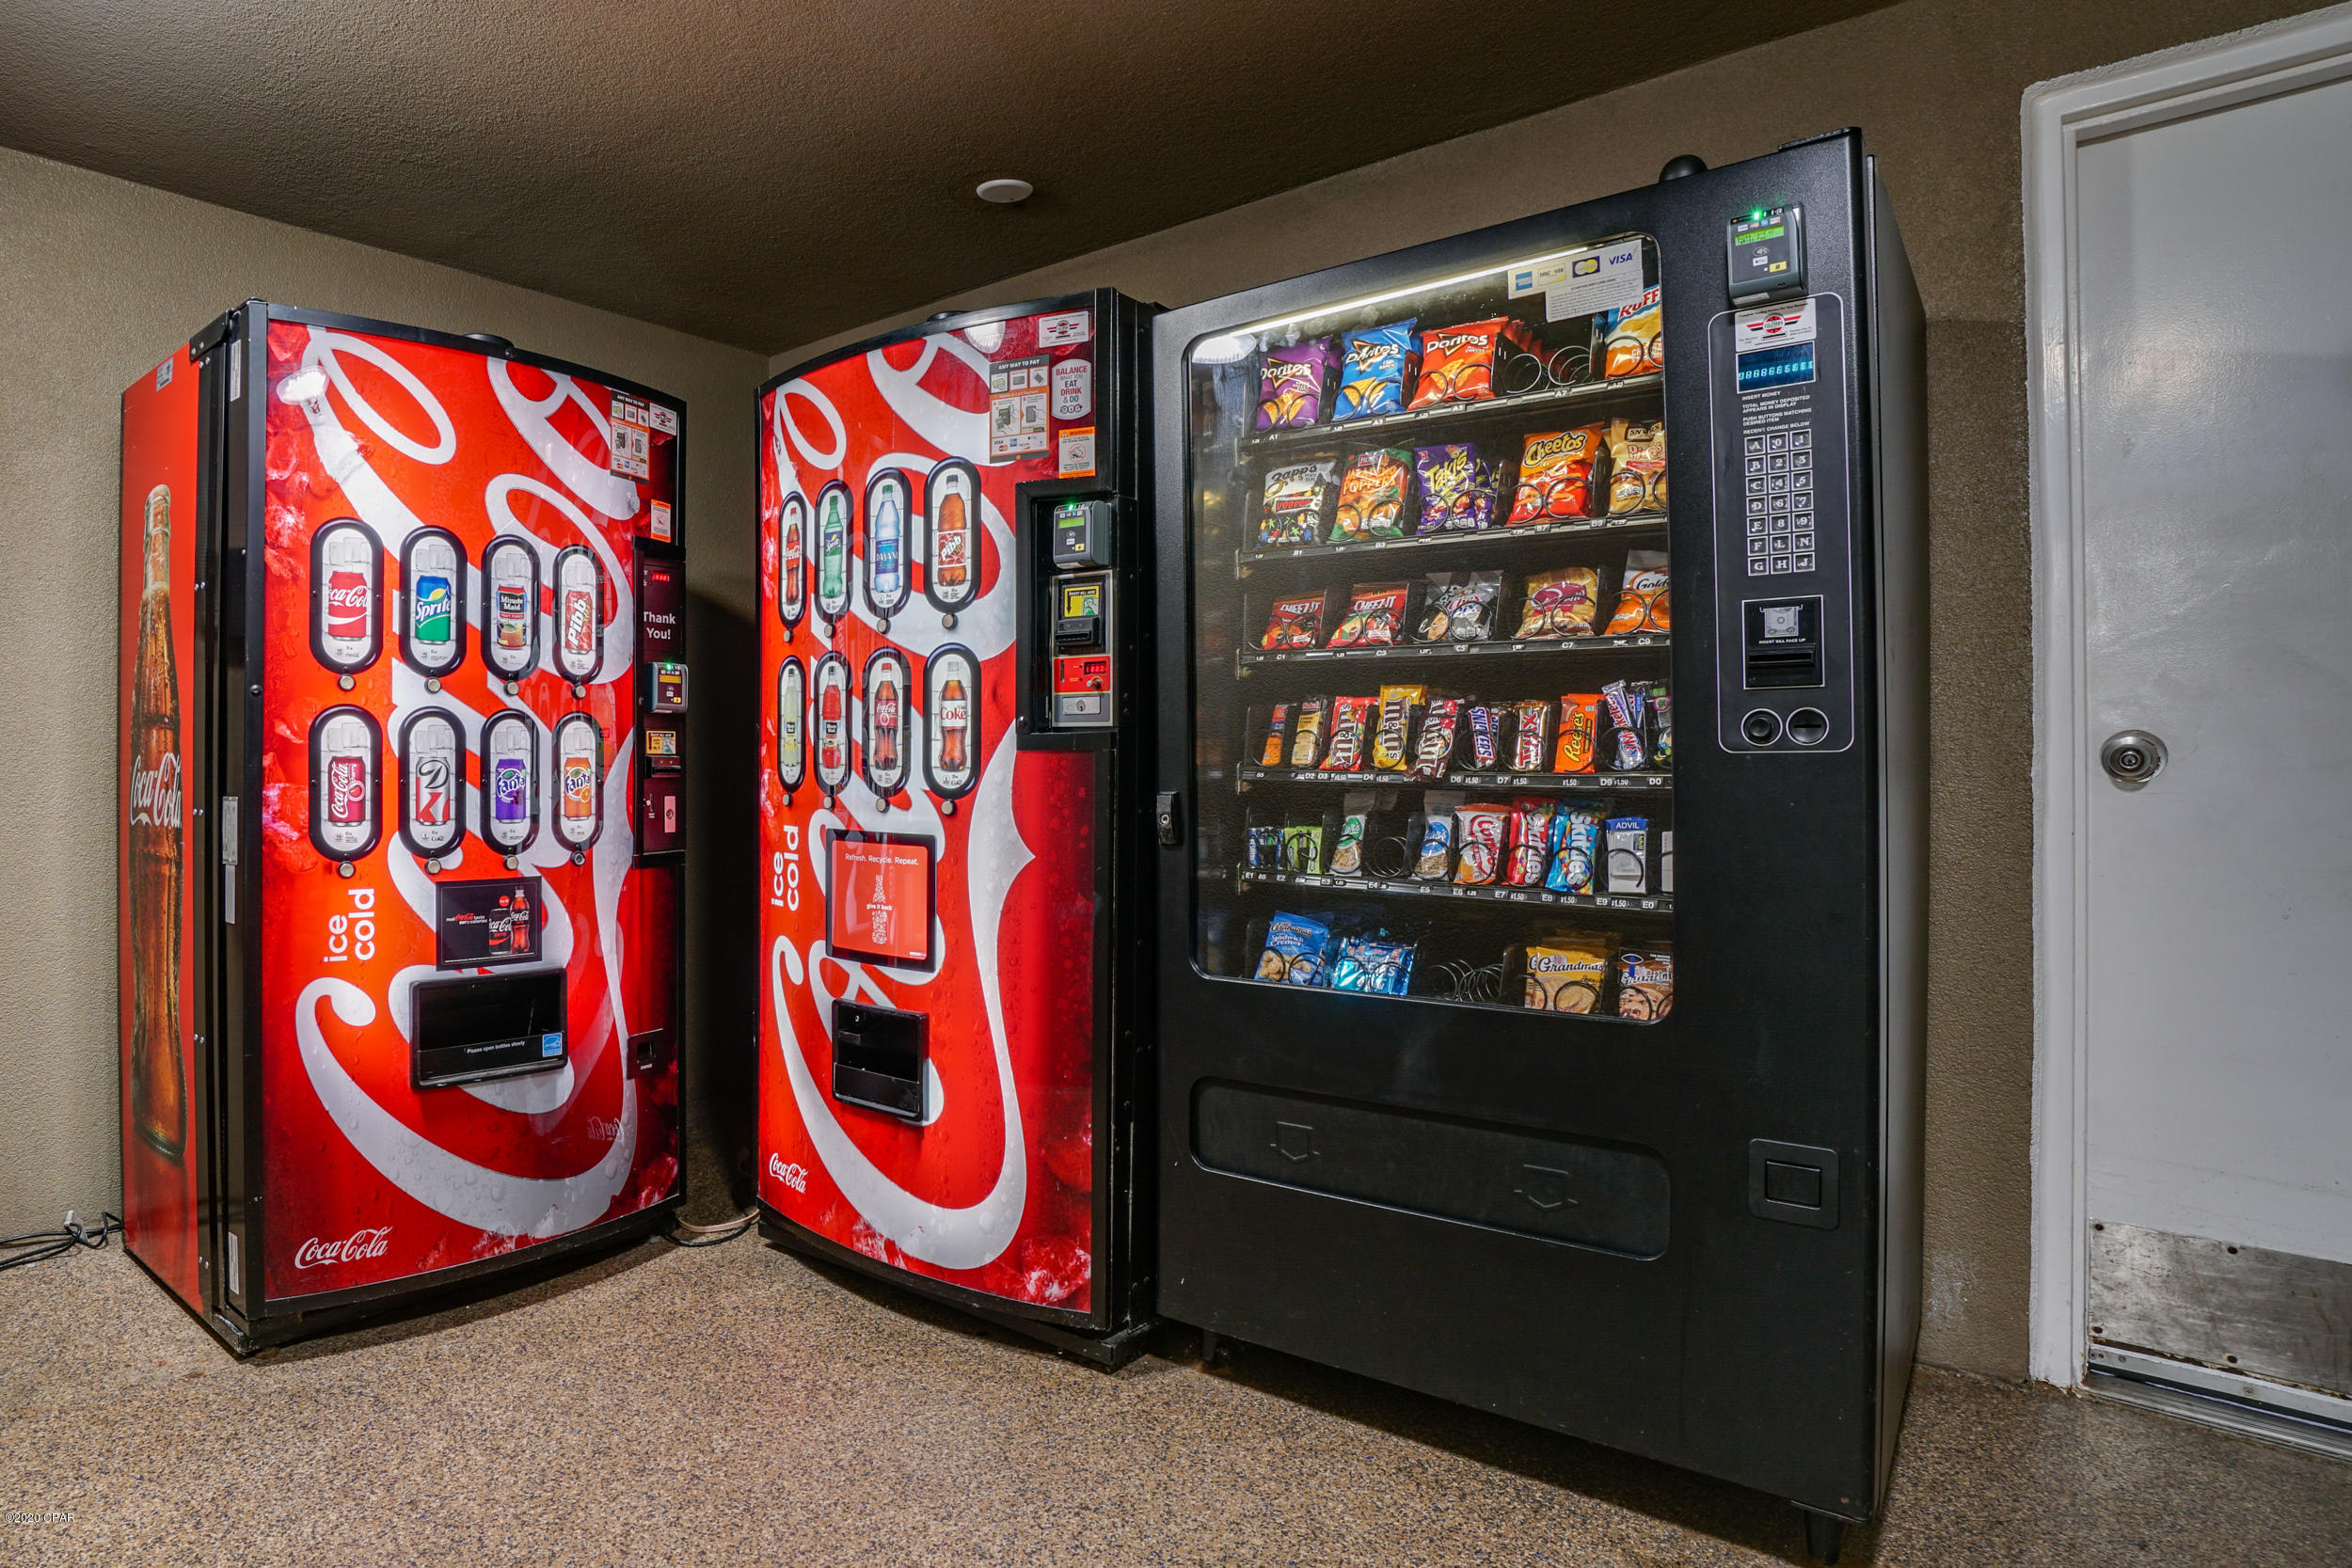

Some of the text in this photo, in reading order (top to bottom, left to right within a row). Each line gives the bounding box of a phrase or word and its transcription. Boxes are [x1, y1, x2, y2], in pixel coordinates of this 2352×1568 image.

[1609, 252, 1633, 265] VISA
[1540, 267, 1565, 278] DISCVER
[1427, 334, 1488, 354] Doritos
[1345, 343, 1400, 364] Doritos
[1056, 365, 1088, 376] BALANCE
[1261, 363, 1312, 380] Doritos
[1064, 379, 1078, 388] EAT
[1060, 388, 1082, 396] DRINK
[1761, 390, 1781, 399] MONEY
[1779, 395, 1811, 404] DEPOSITED
[1742, 405, 1768, 414] APPEARS
[1774, 402, 1797, 410] DISPLAY
[1757, 412, 1784, 420] BUTTONS
[1784, 407, 1812, 417] MATCHING
[1789, 420, 1810, 429] BELOW
[1524, 432, 1587, 467] Cheetos
[1752, 441, 1760, 450] A
[1752, 461, 1760, 469] B
[1775, 458, 1783, 467] 2
[1798, 455, 1806, 465] 3
[1425, 451, 1468, 495] Takis
[1343, 477, 1398, 495] POPPERS
[1753, 482, 1761, 490] C
[1776, 479, 1784, 487] 4
[1799, 476, 1805, 484] 5
[1276, 499, 1311, 511] VOODOO
[1753, 501, 1762, 510] D
[1776, 499, 1784, 508] 6
[1799, 497, 1806, 505] 7
[1754, 521, 1762, 530] E
[1801, 516, 1808, 526] 9
[1754, 542, 1762, 551] F
[1777, 540, 1785, 548] L
[1800, 537, 1810, 546] N
[941, 534, 961, 562] Pibb
[1754, 562, 1763, 571] G
[1776, 561, 1787, 569] H
[1801, 558, 1808, 567] J
[417, 586, 452, 623] Sprite
[501, 595, 523, 605] Minute
[503, 602, 521, 611] Maid
[567, 597, 588, 647] Pibb
[644, 611, 675, 624] Thank
[646, 627, 671, 640] You!
[941, 706, 966, 721] Coke
[1564, 711, 1585, 763] Reese's
[497, 774, 526, 799] Fanta
[565, 772, 590, 794] Fanta
[1513, 777, 1527, 785] $1.50
[1562, 778, 1577, 786] $1.50
[1600, 778, 1613, 786] D9
[130, 752, 183, 829] Coca-Cola
[331, 761, 349, 818] Coca-Cola
[1524, 813, 1547, 884] Skittles
[1565, 811, 1594, 885] Skittles
[845, 852, 918, 865] Refresh. Recycle. Repeat.
[783, 825, 799, 911] cold
[771, 851, 785, 907] ice
[1510, 893, 1525, 901] $1.50
[1542, 894, 1553, 902] E8
[1597, 897, 1608, 906] E9
[1611, 899, 1627, 908] $1.50
[348, 888, 375, 960] cold
[1270, 922, 1312, 937] Grandma's
[324, 915, 348, 962] ice
[1270, 934, 1304, 943] Sandwich
[1270, 939, 1301, 947] Cremes
[1537, 956, 1603, 974] Grandma's
[467, 1046, 483, 1054] Please
[769, 1152, 809, 1194] Coca-Cola
[294, 1226, 393, 1270] Coca-Cola
